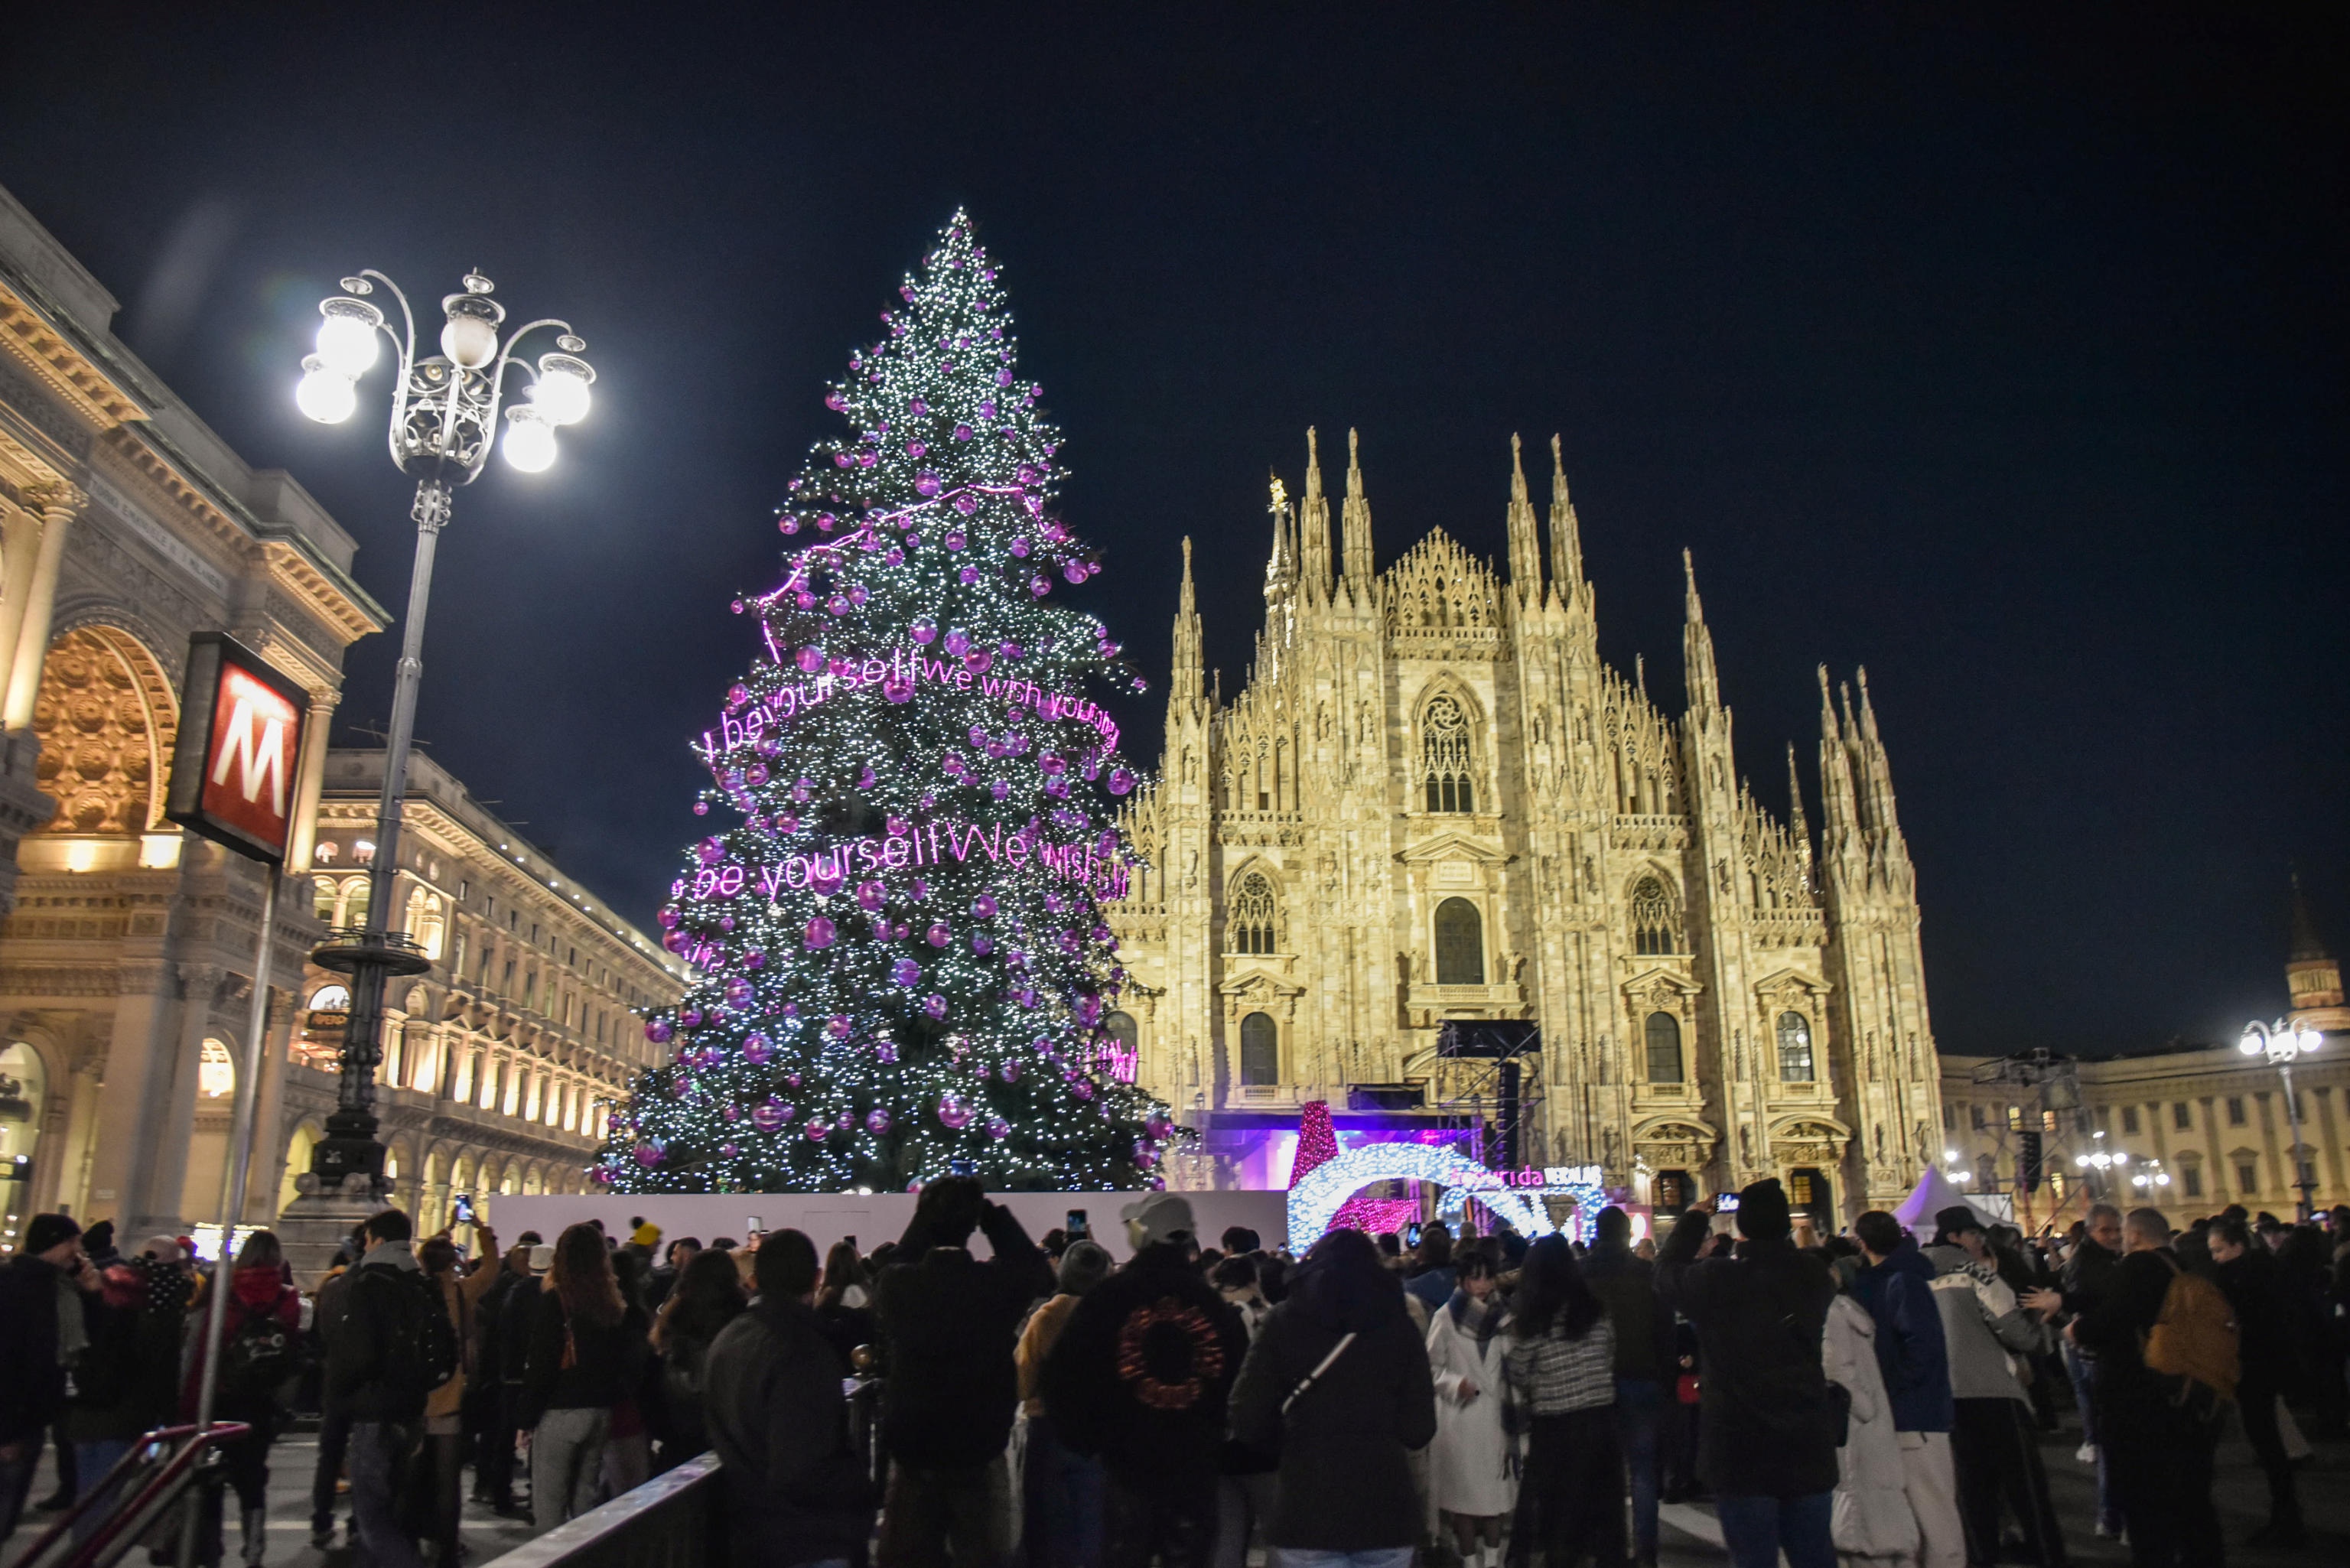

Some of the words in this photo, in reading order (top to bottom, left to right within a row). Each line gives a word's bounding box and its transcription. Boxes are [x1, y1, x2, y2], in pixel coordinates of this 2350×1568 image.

[981, 675, 1043, 708] wish
[211, 696, 285, 819] M
[760, 821, 939, 903] yourself
